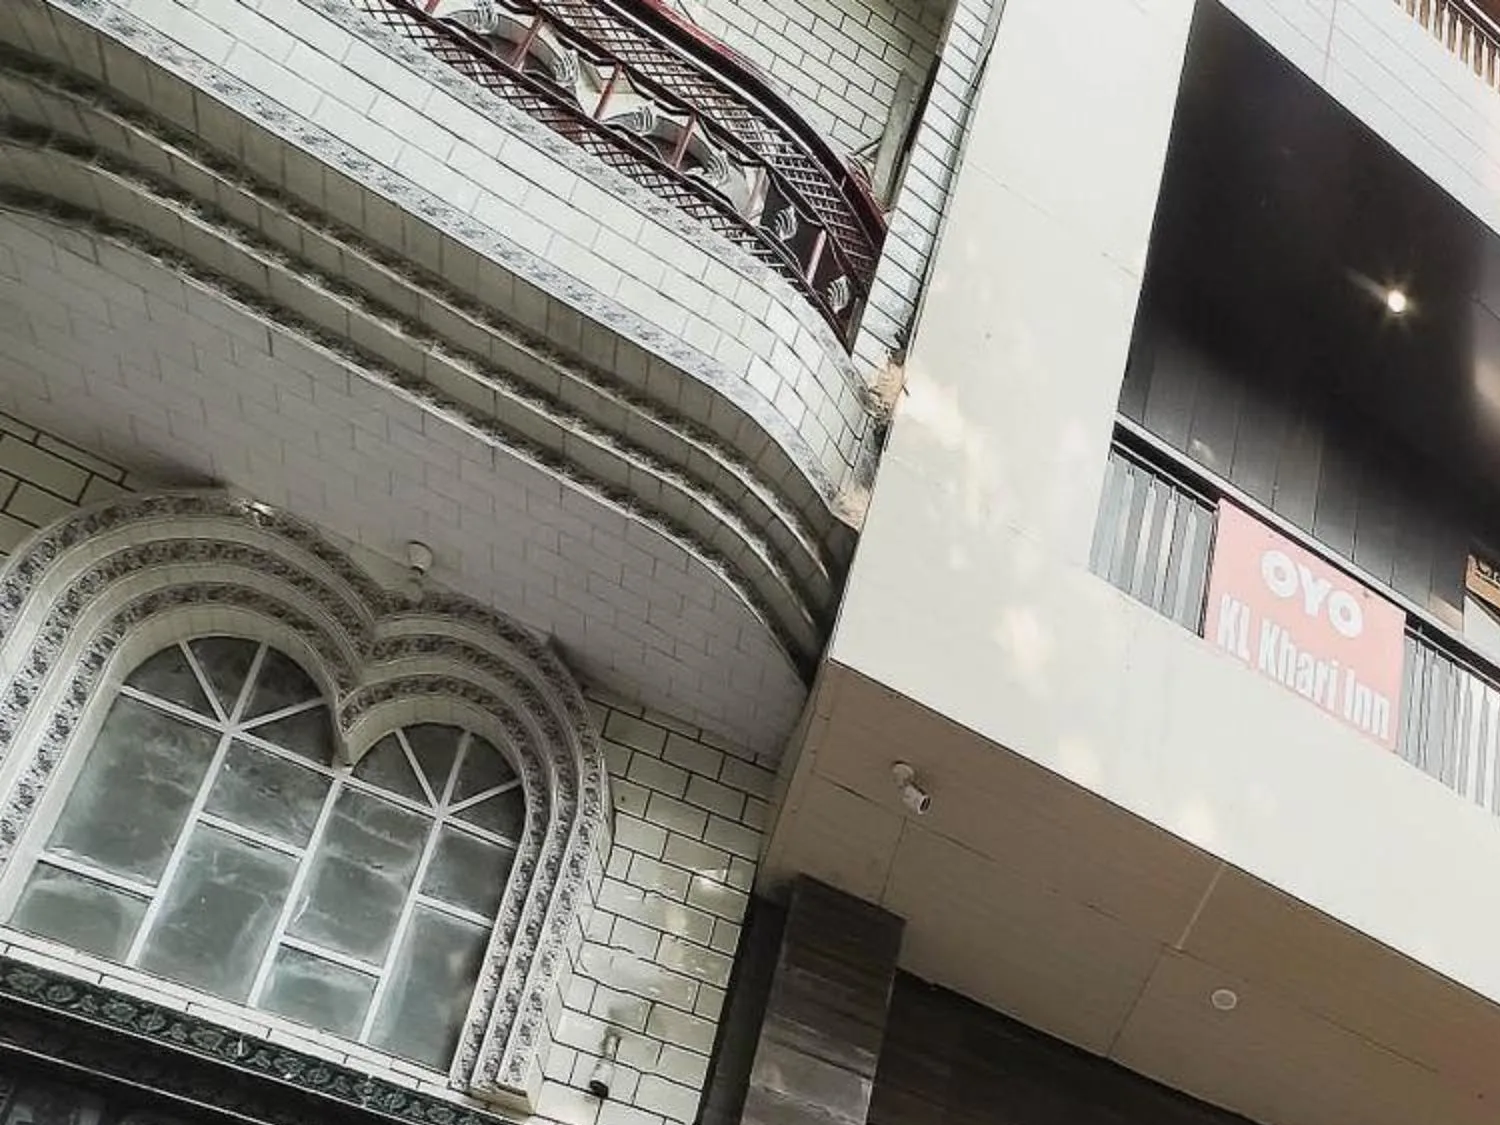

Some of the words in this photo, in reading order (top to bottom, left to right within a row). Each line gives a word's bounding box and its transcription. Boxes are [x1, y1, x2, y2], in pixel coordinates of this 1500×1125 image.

[1261, 549, 1363, 639] OYO
[1217, 593, 1251, 661] KL
[1258, 617, 1339, 711] Khari
[1343, 667, 1391, 740] Inn
